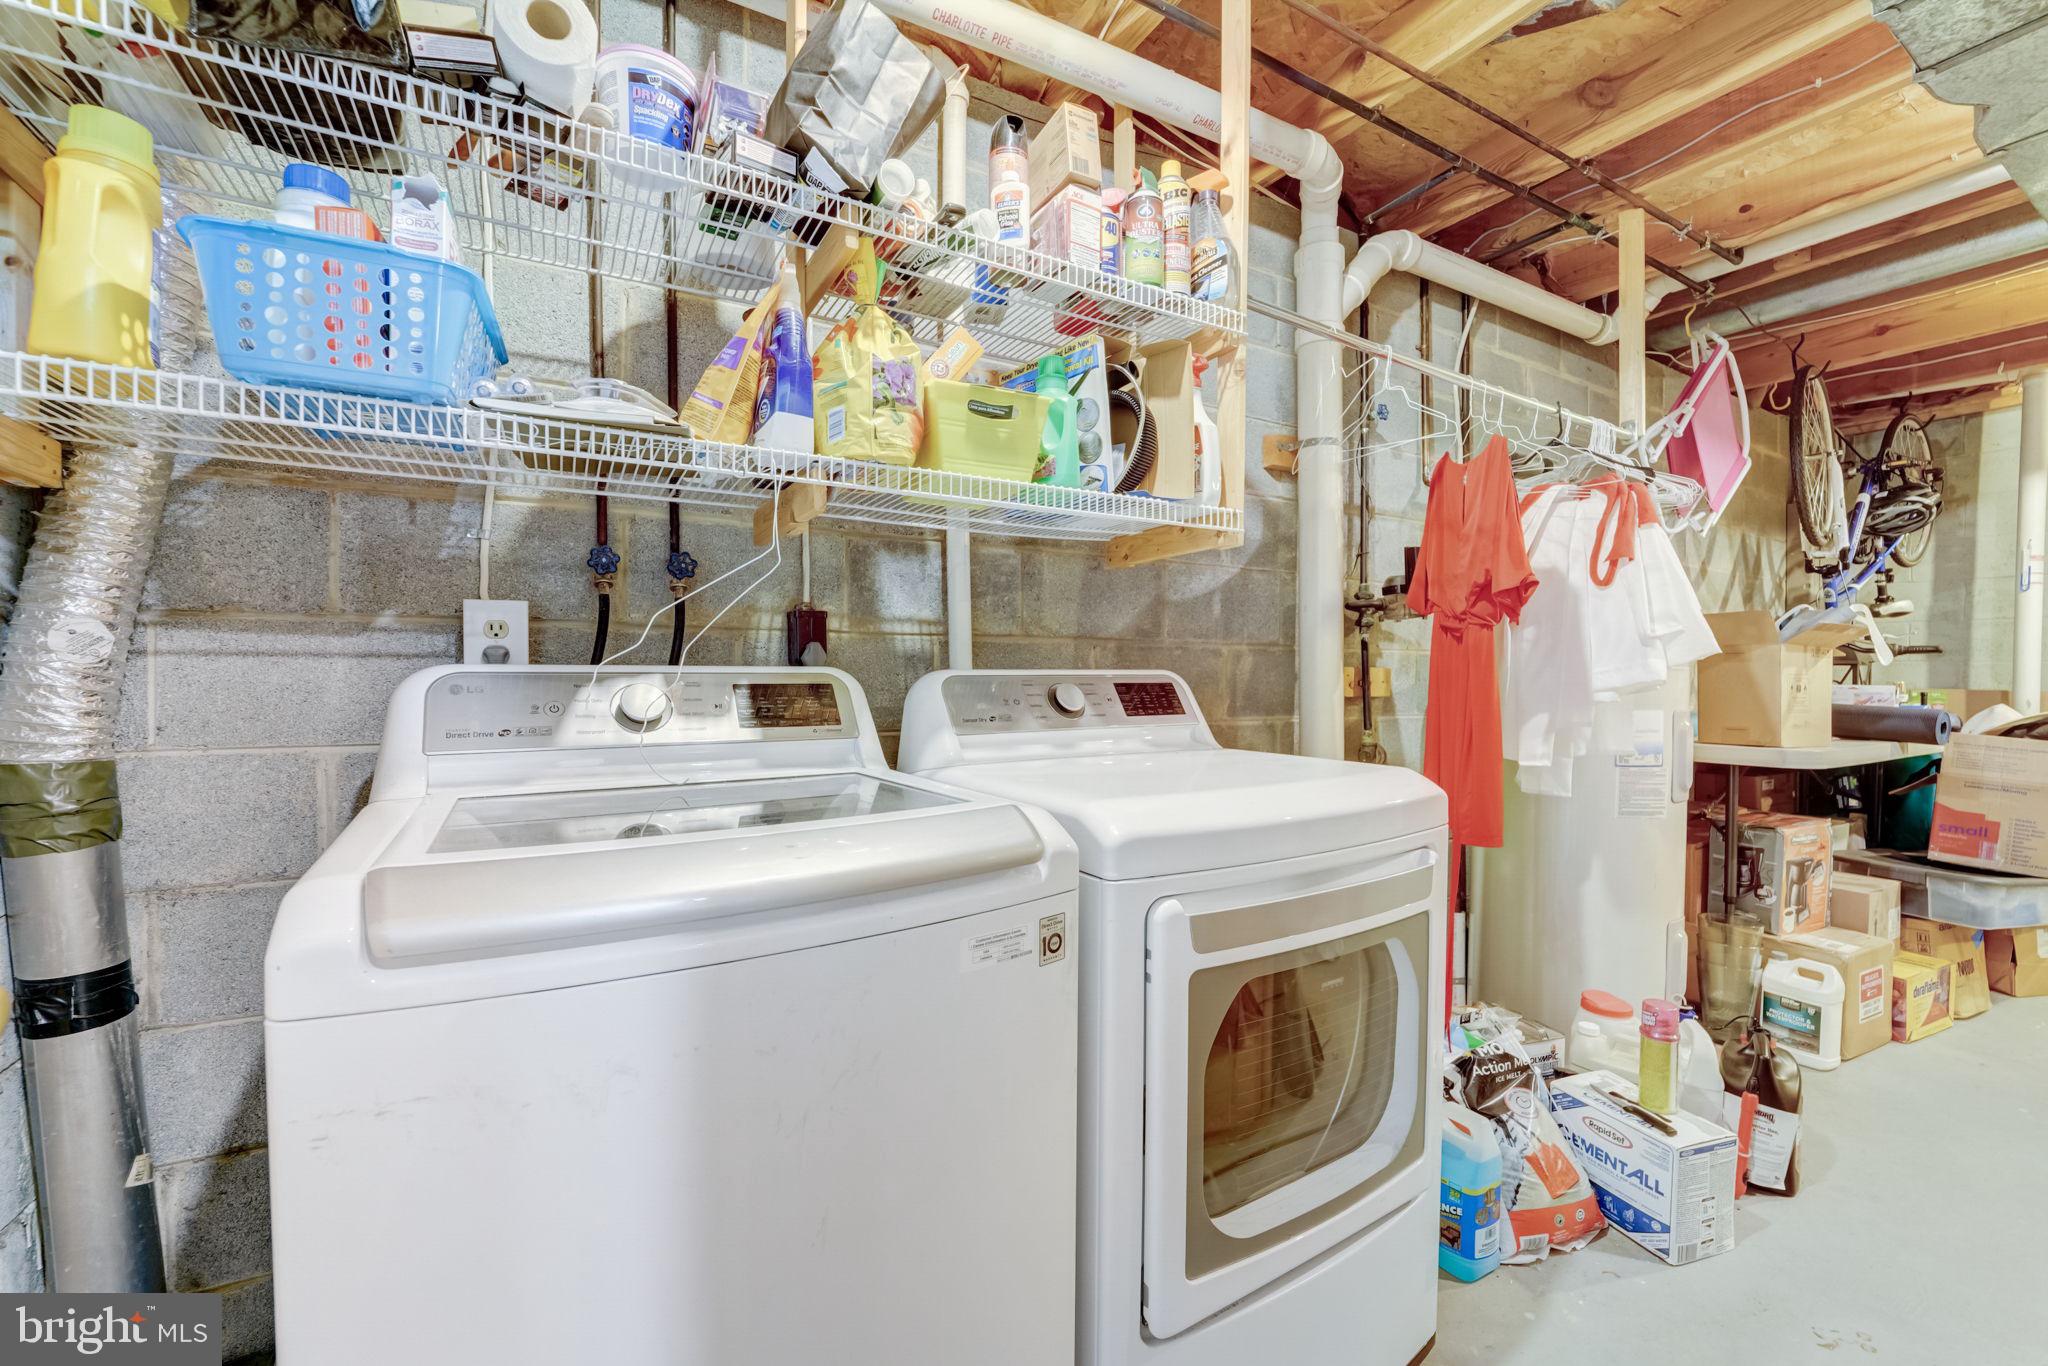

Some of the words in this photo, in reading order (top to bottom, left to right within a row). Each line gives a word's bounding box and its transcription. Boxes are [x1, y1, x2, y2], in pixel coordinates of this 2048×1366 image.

[932, 7, 988, 39] CHARLOTTE
[991, 31, 1013, 50] PIPE
[633, 104, 669, 123] Spackling
[1192, 112, 1221, 134] CHARLO
[807, 172, 823, 190] DAP
[396, 216, 440, 231] BORAX
[999, 211, 1019, 222] School
[1026, 360, 1038, 372] Drye
[466, 684, 484, 694] LG
[445, 731, 471, 739] Direct
[472, 730, 495, 739] Drive
[1938, 823, 1989, 838] small
[1042, 932, 1062, 957] 10
[1913, 978, 1940, 998] duraflame
[1766, 1012, 1815, 1031] WATERPROOFER
[1769, 1007, 1805, 1022] PROTECTOR
[1805, 1017, 1812, 1025] &
[1473, 1060, 1511, 1077] Action
[1514, 1057, 1528, 1069] Me
[1495, 1075, 1505, 1084] ICE
[1506, 1071, 1521, 1081] MELT
[1588, 1119, 1612, 1139] Rapid
[1612, 1131, 1626, 1145] Set
